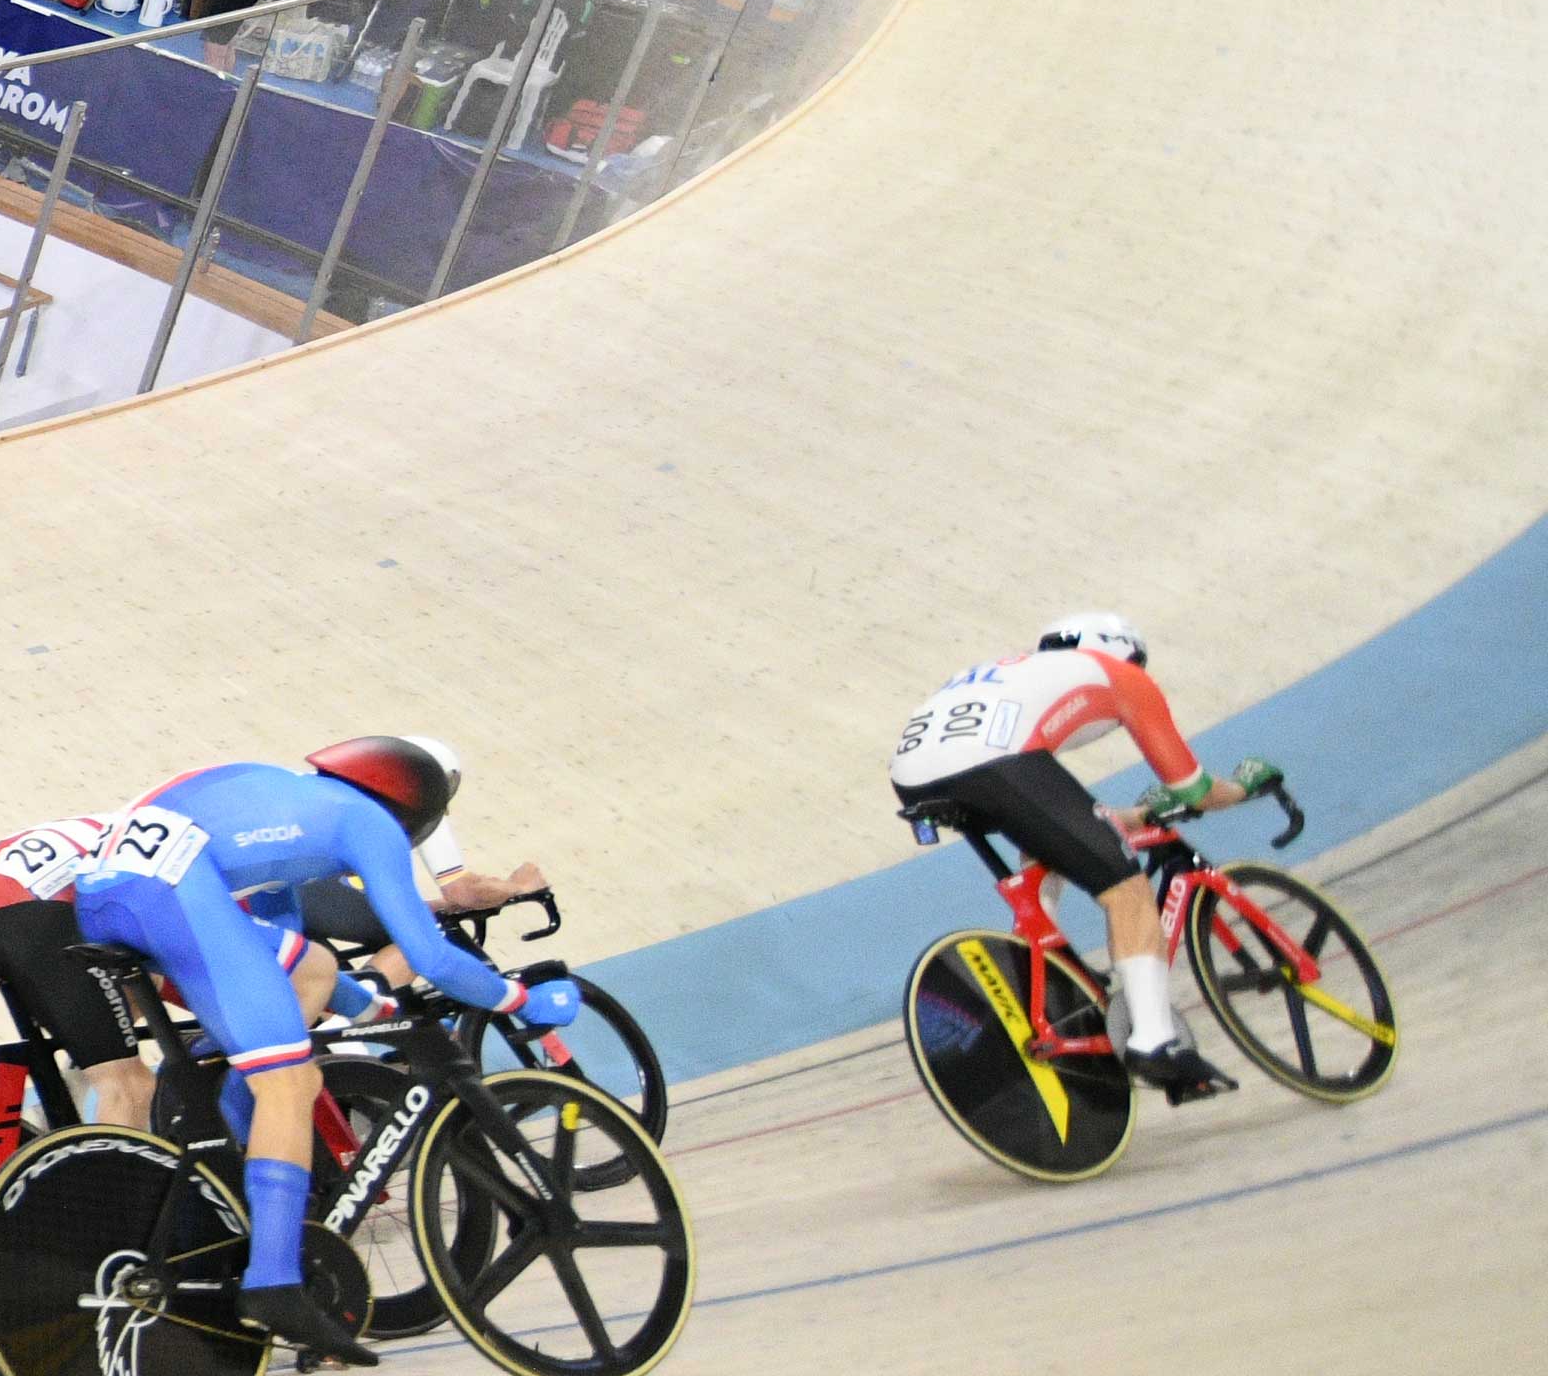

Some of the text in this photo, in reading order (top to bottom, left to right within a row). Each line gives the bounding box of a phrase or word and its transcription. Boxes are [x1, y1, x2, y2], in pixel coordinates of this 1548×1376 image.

[6, 837, 56, 874] 29
[116, 819, 170, 861] 23
[341, 1021, 413, 1038] PINARELLO
[324, 1085, 430, 1233] PINARELLO
